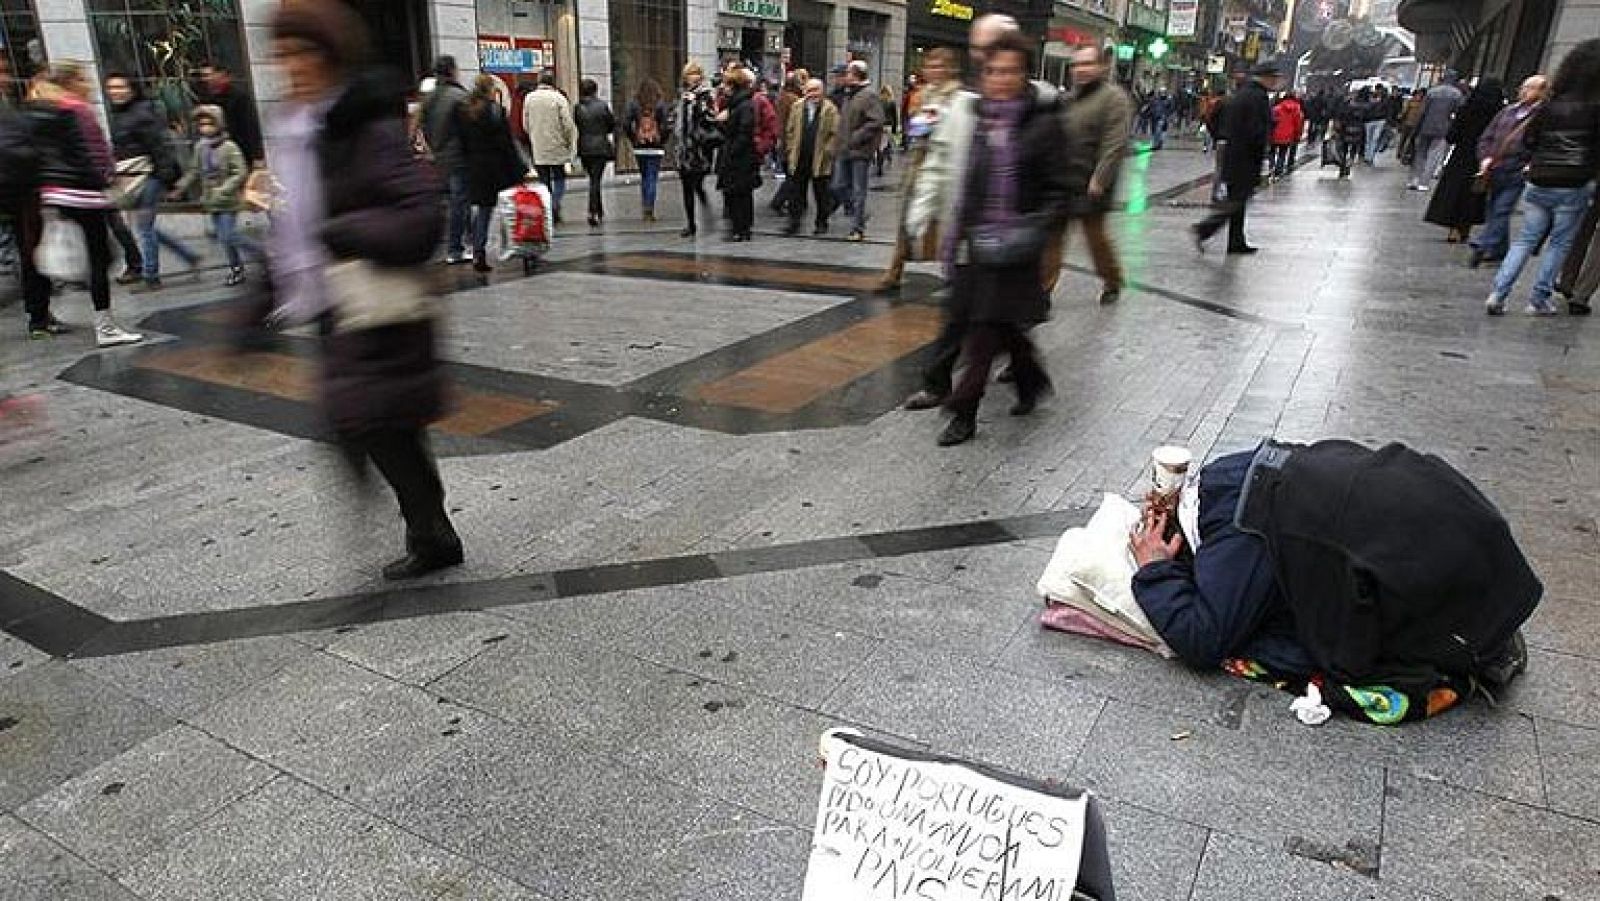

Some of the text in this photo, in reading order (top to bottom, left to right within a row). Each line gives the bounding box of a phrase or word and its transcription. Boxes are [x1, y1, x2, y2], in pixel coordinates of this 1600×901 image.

[832, 749, 1068, 849] SOY PORTUGUES
[879, 801, 926, 833] UNA
[823, 811, 887, 848] PARA
